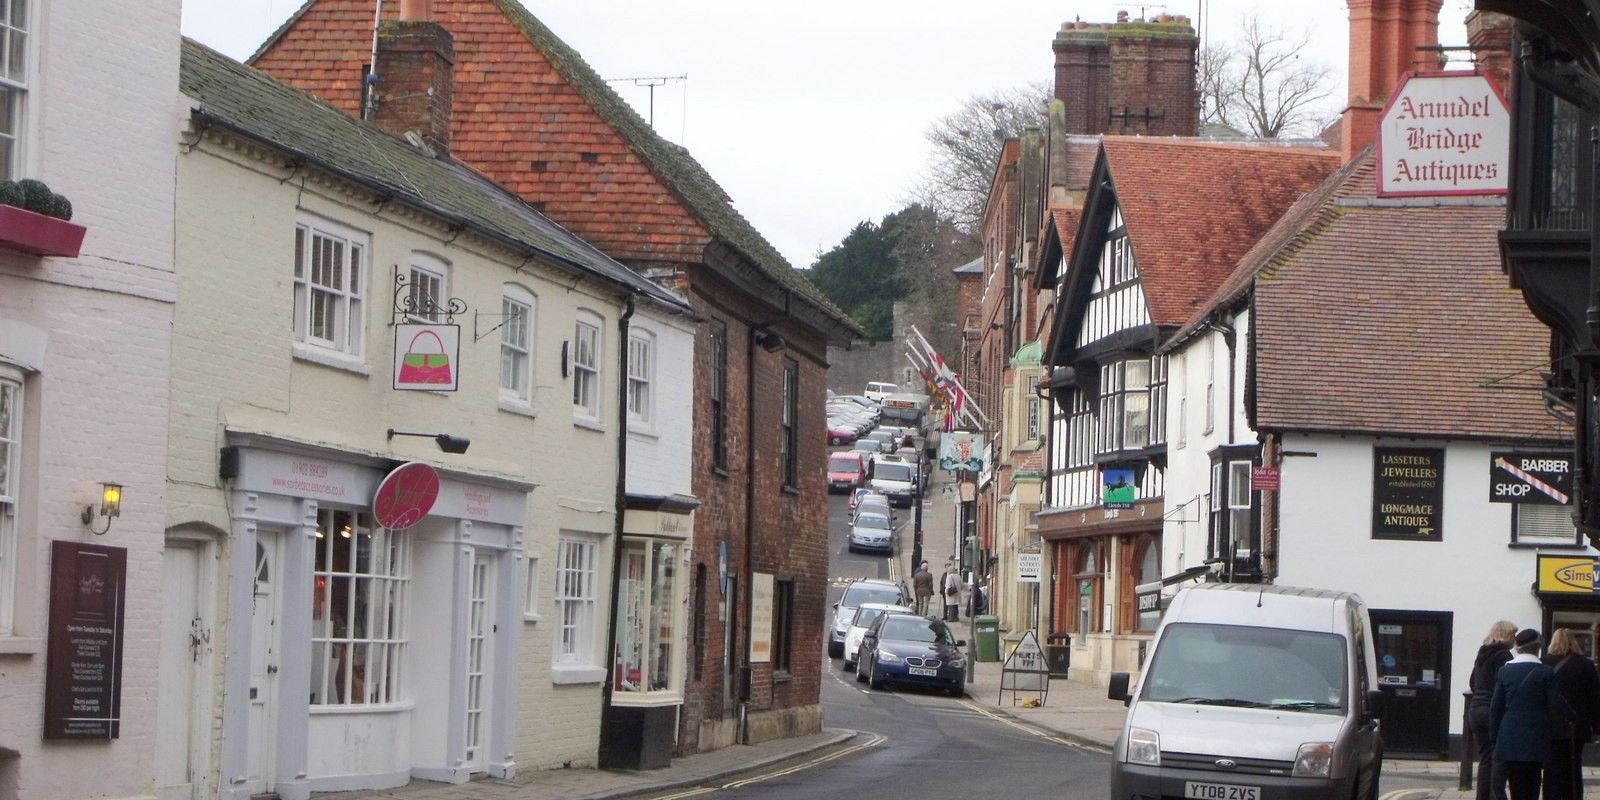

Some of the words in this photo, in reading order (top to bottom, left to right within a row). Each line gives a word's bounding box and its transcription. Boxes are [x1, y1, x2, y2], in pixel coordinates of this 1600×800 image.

[1396, 94, 1490, 119] Arundel
[1406, 127, 1483, 154] Bridge
[1392, 159, 1498, 186] Antiques
[1382, 455, 1431, 465] LASSETERS
[1521, 458, 1569, 473] BARBER
[1380, 467, 1437, 478] JEWELLERS
[1495, 483, 1531, 496] SHOP
[1381, 503, 1433, 515] LONGMACE
[1384, 515, 1429, 526] ANTIQUES
[1563, 569, 1592, 581] Sims
[1191, 783, 1226, 799] YT08
[1229, 787, 1256, 800] ZVS
